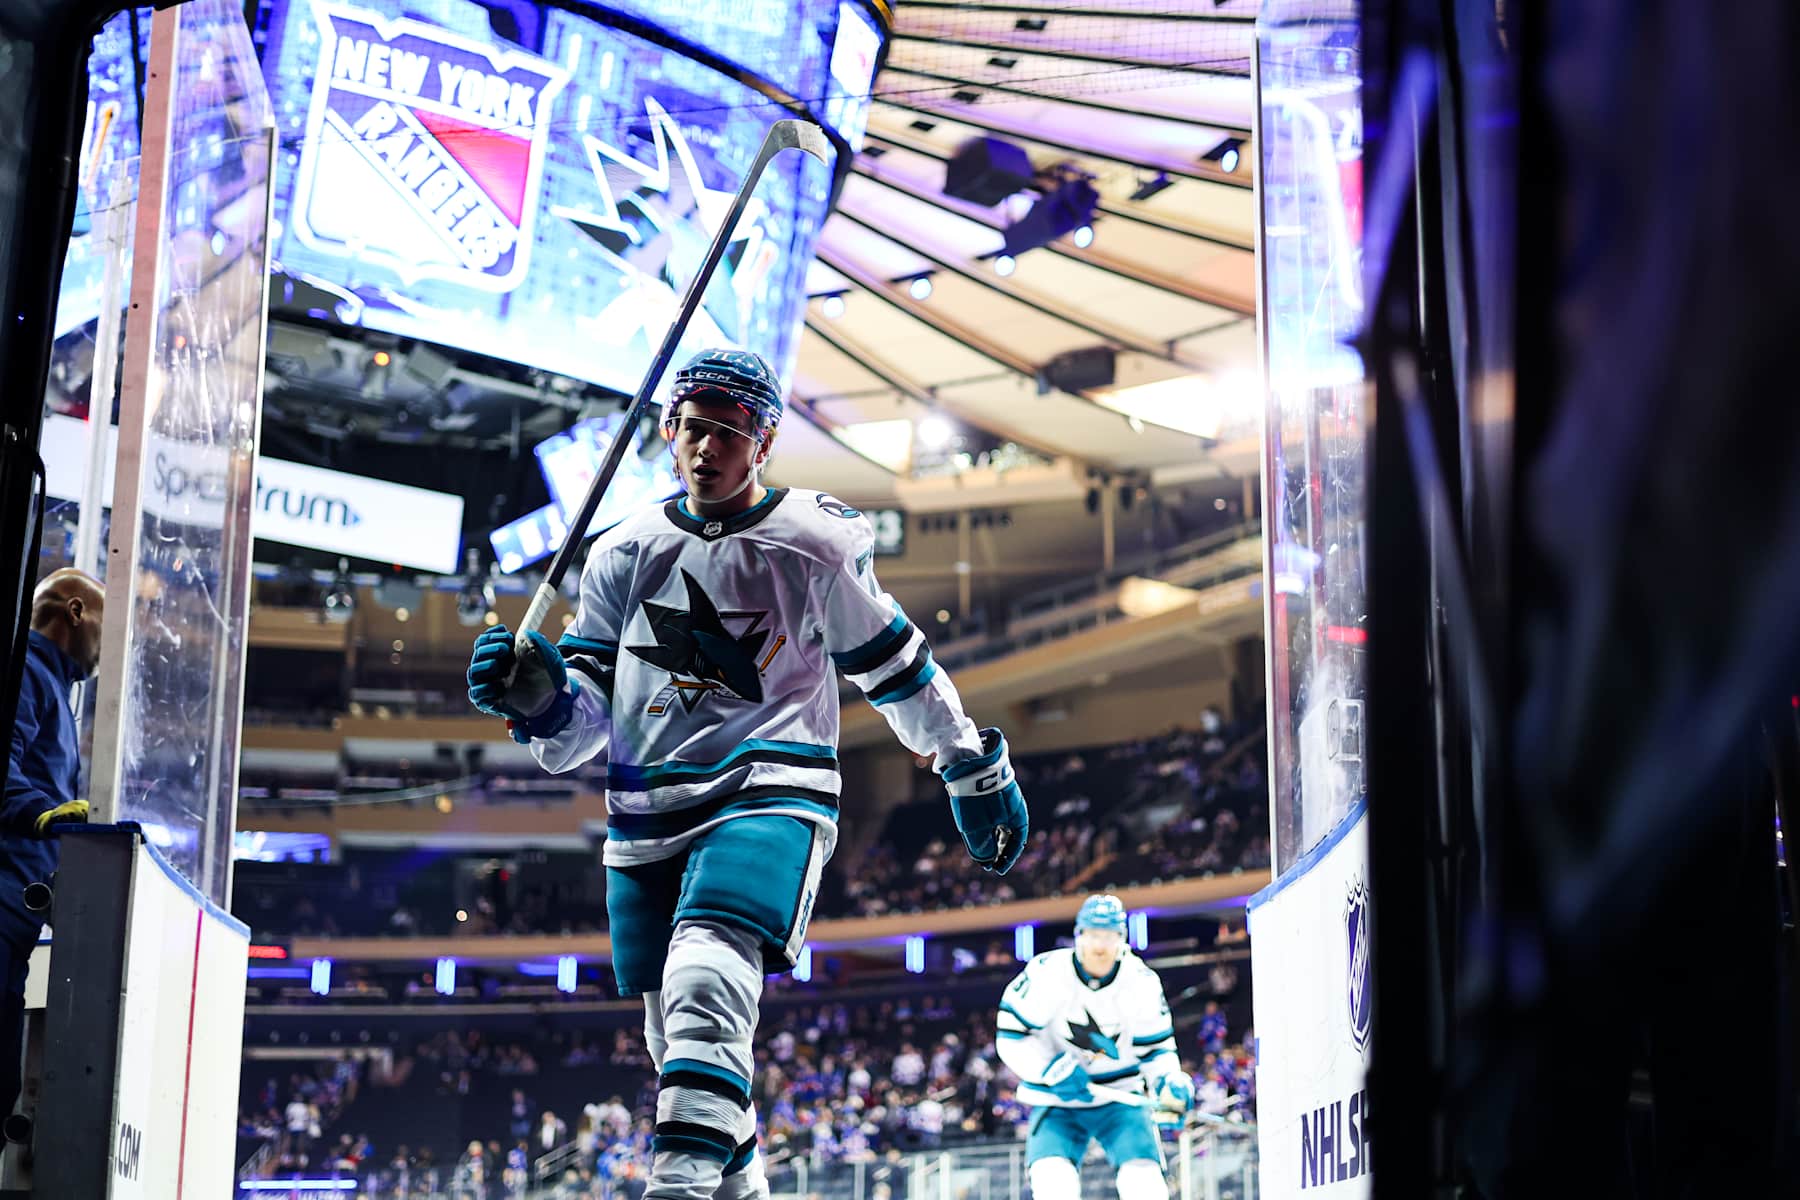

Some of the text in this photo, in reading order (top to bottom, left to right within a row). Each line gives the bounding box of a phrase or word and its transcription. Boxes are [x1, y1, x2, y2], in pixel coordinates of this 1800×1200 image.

[333, 36, 537, 126] NEW YORK
[352, 101, 518, 268] RANGERS
[695, 370, 731, 381] CCM
[153, 451, 350, 526] Sptrum
